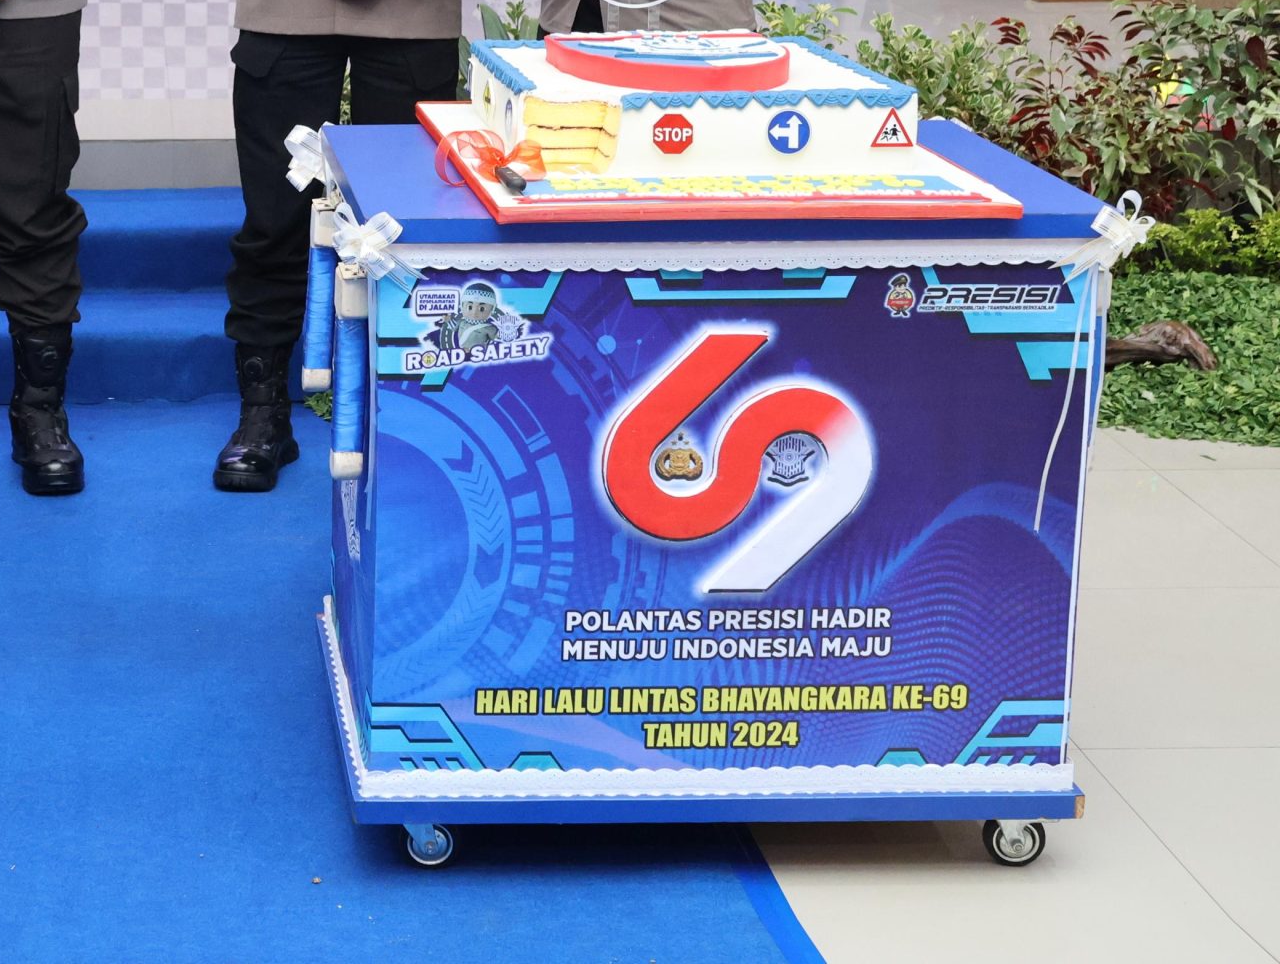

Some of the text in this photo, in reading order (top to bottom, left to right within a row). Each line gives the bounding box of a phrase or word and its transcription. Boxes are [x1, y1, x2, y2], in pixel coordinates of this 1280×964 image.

[654, 128, 693, 142] STOP
[922, 286, 1059, 305] PRESISI
[406, 336, 549, 371] ROAD SAFETY
[564, 607, 892, 633] POLANTAS PRESISI HADIR
[561, 636, 892, 662] MENUJU INDONESIA MAJU
[475, 683, 970, 715] HARI LALU LINTAS BHAYANGKARA KE-69
[642, 720, 799, 749] TAHUN 2024
